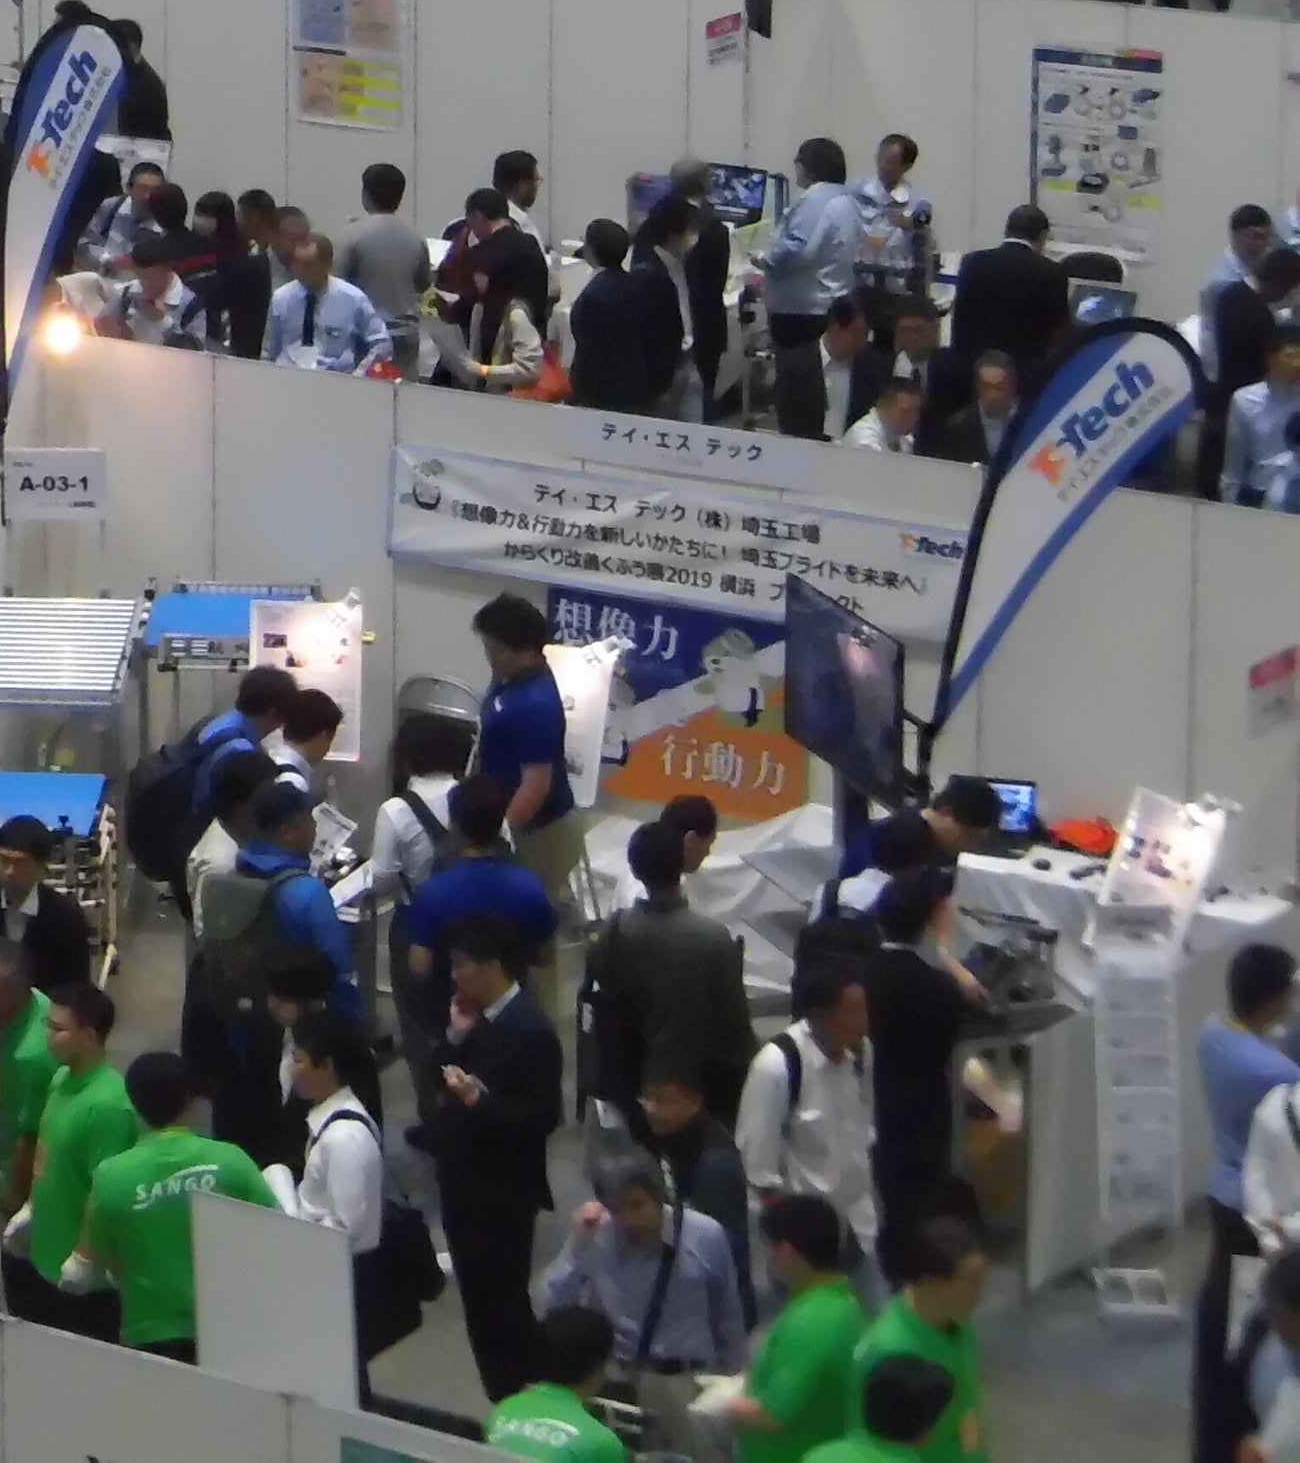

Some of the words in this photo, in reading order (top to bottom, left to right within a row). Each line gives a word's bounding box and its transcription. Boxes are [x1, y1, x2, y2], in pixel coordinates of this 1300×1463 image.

[18, 475, 89, 492] A-03-1
[554, 598, 680, 660] 想像力
[660, 734, 786, 795] 行動力
[132, 1165, 218, 1210] SANGO
